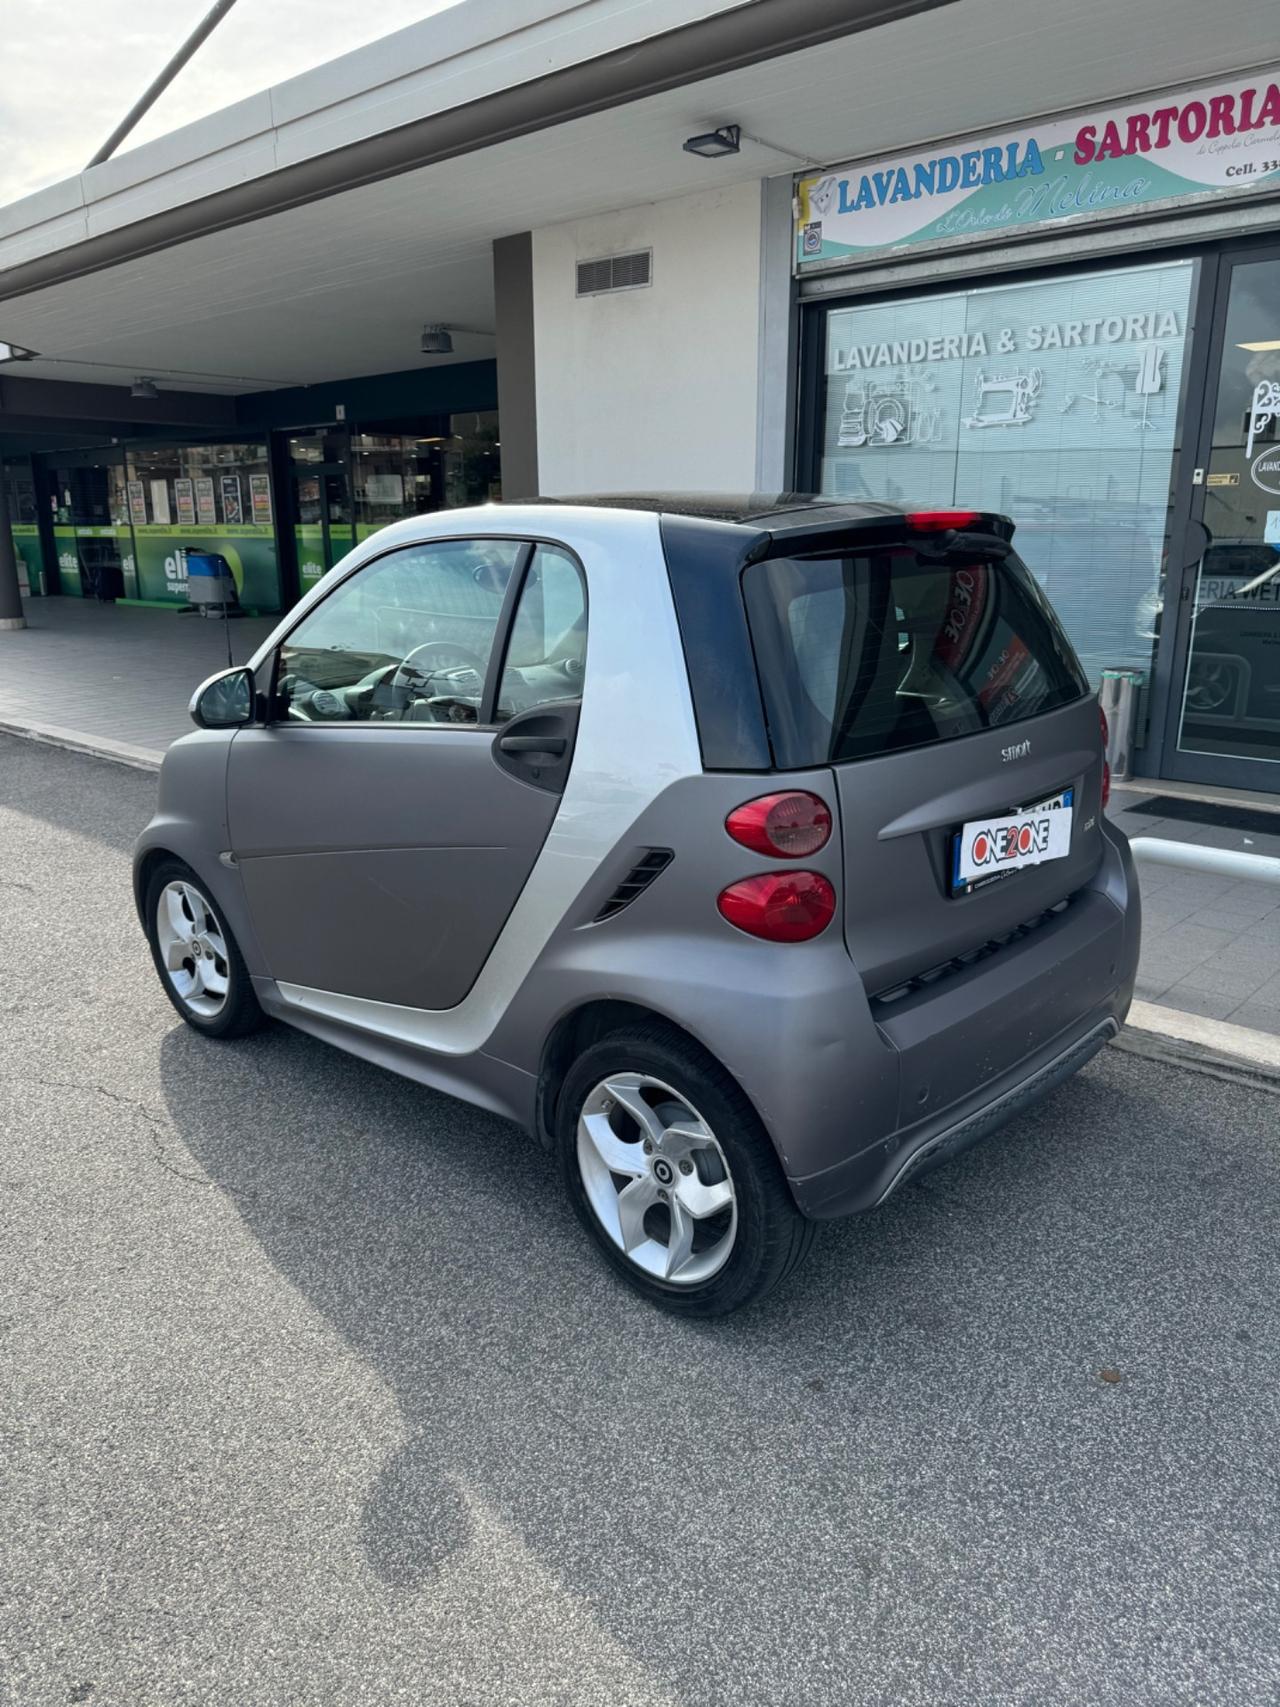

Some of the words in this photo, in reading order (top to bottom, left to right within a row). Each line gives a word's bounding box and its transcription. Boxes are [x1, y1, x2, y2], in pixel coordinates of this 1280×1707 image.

[838, 138, 1045, 214] LAVANDERIA
[1073, 83, 1280, 165] SARTORIA
[1225, 162, 1257, 177] Cell.
[1261, 159, 1280, 173] 33
[1014, 171, 1151, 217] Melina
[833, 331, 988, 372] LAVANDERIA
[996, 327, 1016, 353] &
[1025, 310, 1179, 351] SARTORIA
[1001, 739, 1031, 762] smart
[971, 818, 1050, 867] ONE2ONE
